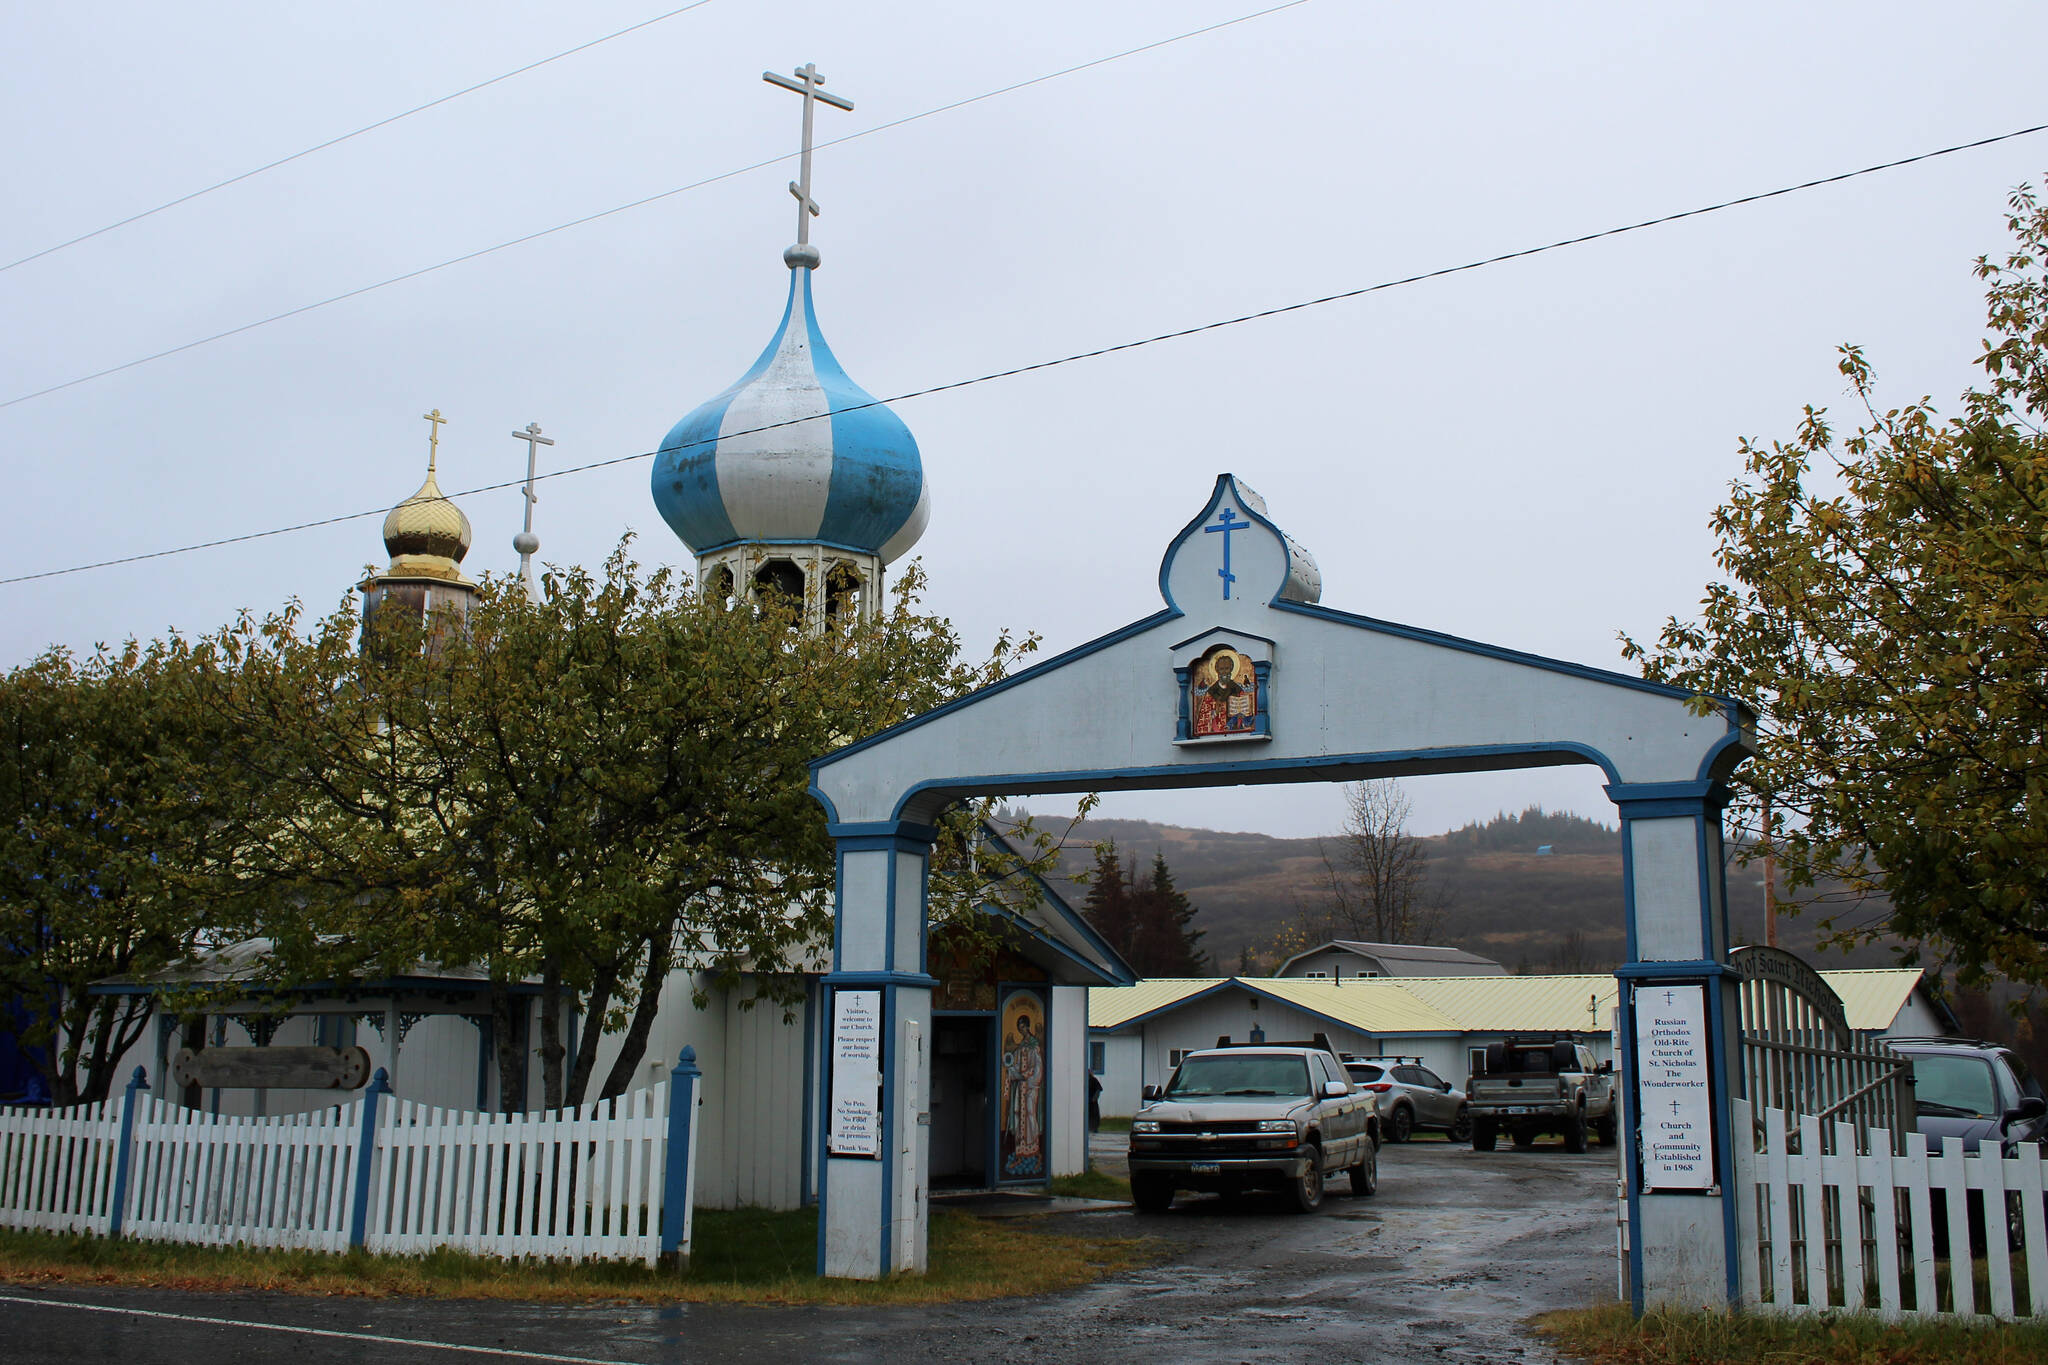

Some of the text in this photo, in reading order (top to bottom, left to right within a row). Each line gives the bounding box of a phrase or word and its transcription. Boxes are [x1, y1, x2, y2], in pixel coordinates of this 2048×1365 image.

[1793, 962, 1843, 1026] Nicholas
[1655, 1018, 1687, 1026] Russian
[1651, 1028, 1691, 1036] Orthodox
[1654, 1038, 1689, 1046] Old-Rite
[1684, 1048, 1693, 1056] of
[1648, 1059, 1697, 1067] St. Nicholas
[1665, 1069, 1682, 1077] The
[1642, 1080, 1705, 1088] Wonderworker
[1660, 1121, 1692, 1129] Church
[1668, 1132, 1685, 1140] and
[1652, 1142, 1701, 1152] Community
[1654, 1153, 1701, 1161] Established
[1663, 1163, 1694, 1171] in 1968
